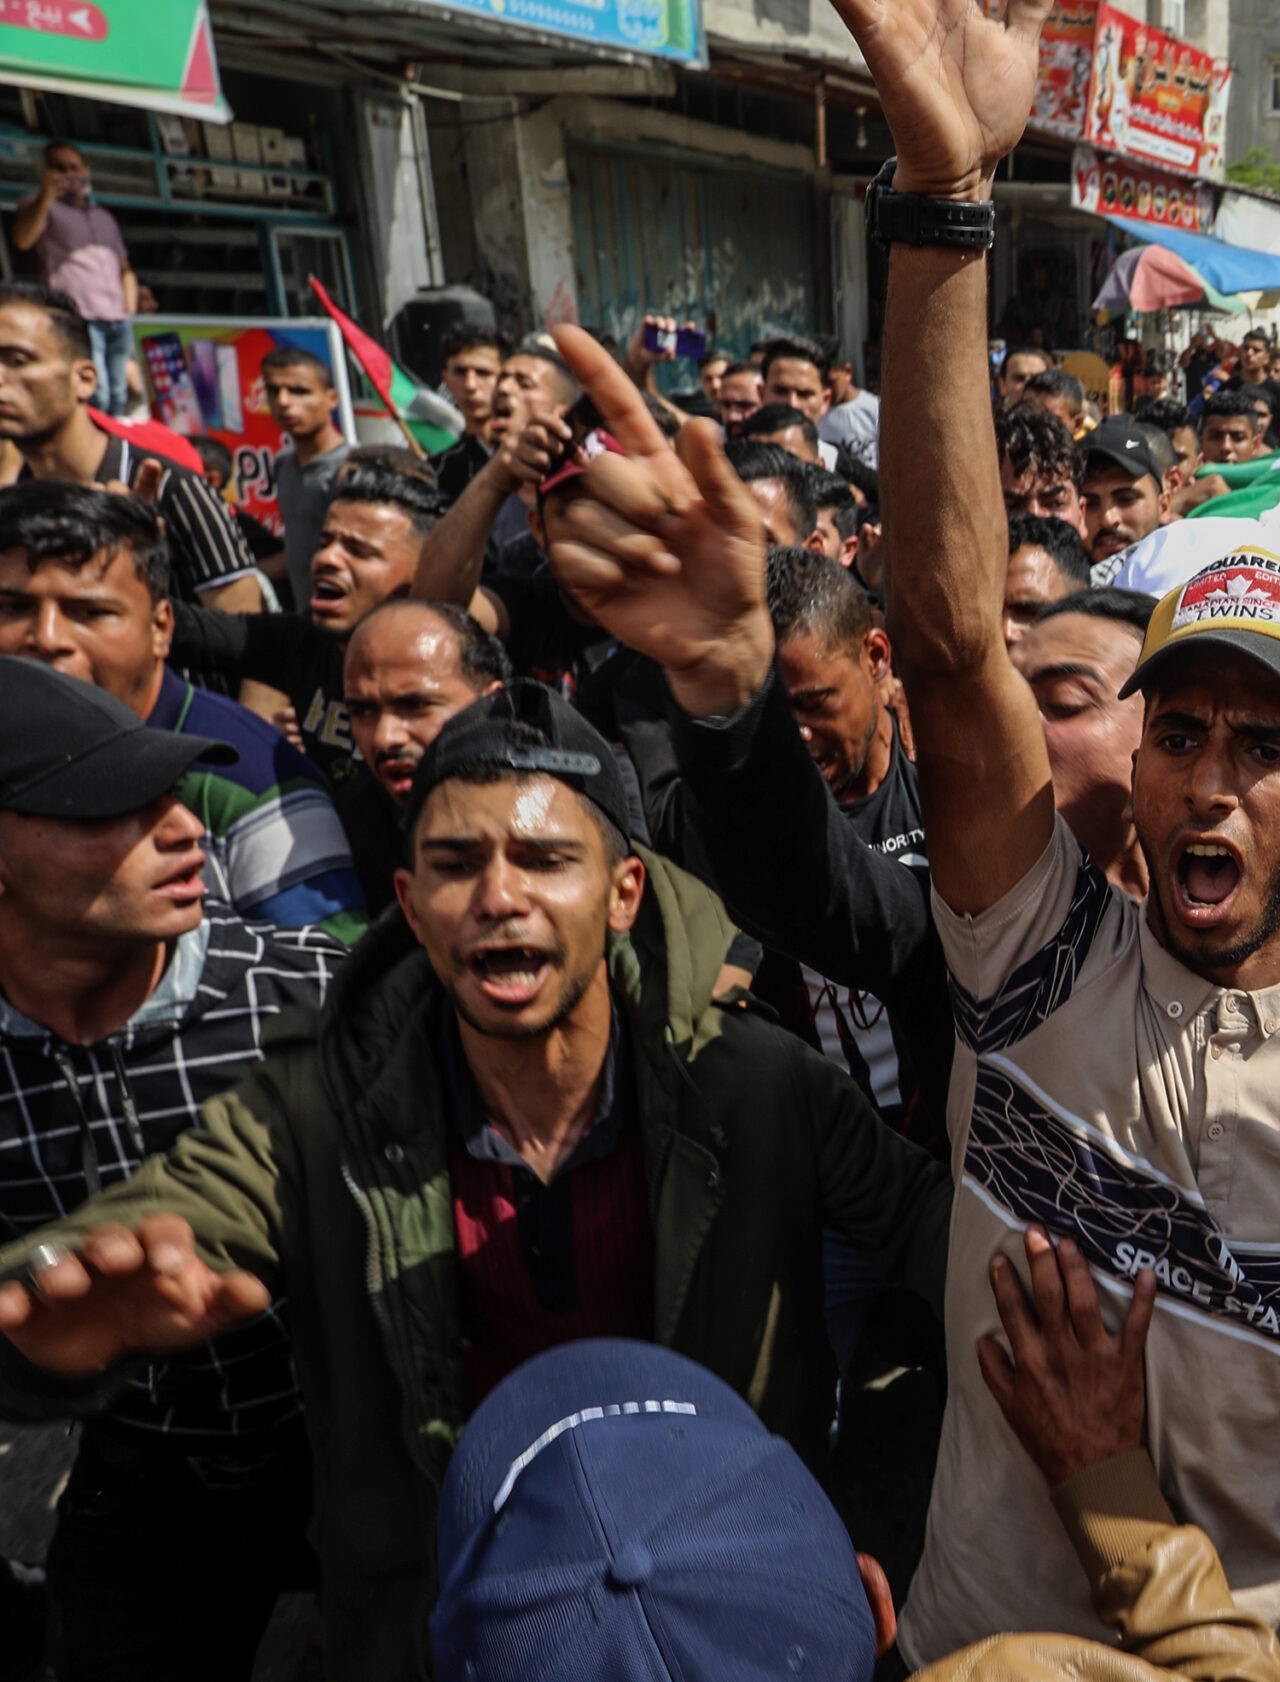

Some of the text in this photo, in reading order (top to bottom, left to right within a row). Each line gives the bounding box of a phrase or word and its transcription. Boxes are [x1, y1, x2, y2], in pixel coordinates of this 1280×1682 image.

[1197, 604, 1274, 621] TWINS
[1242, 598, 1279, 610] SINCE
[1111, 1241, 1213, 1305] SPACE
